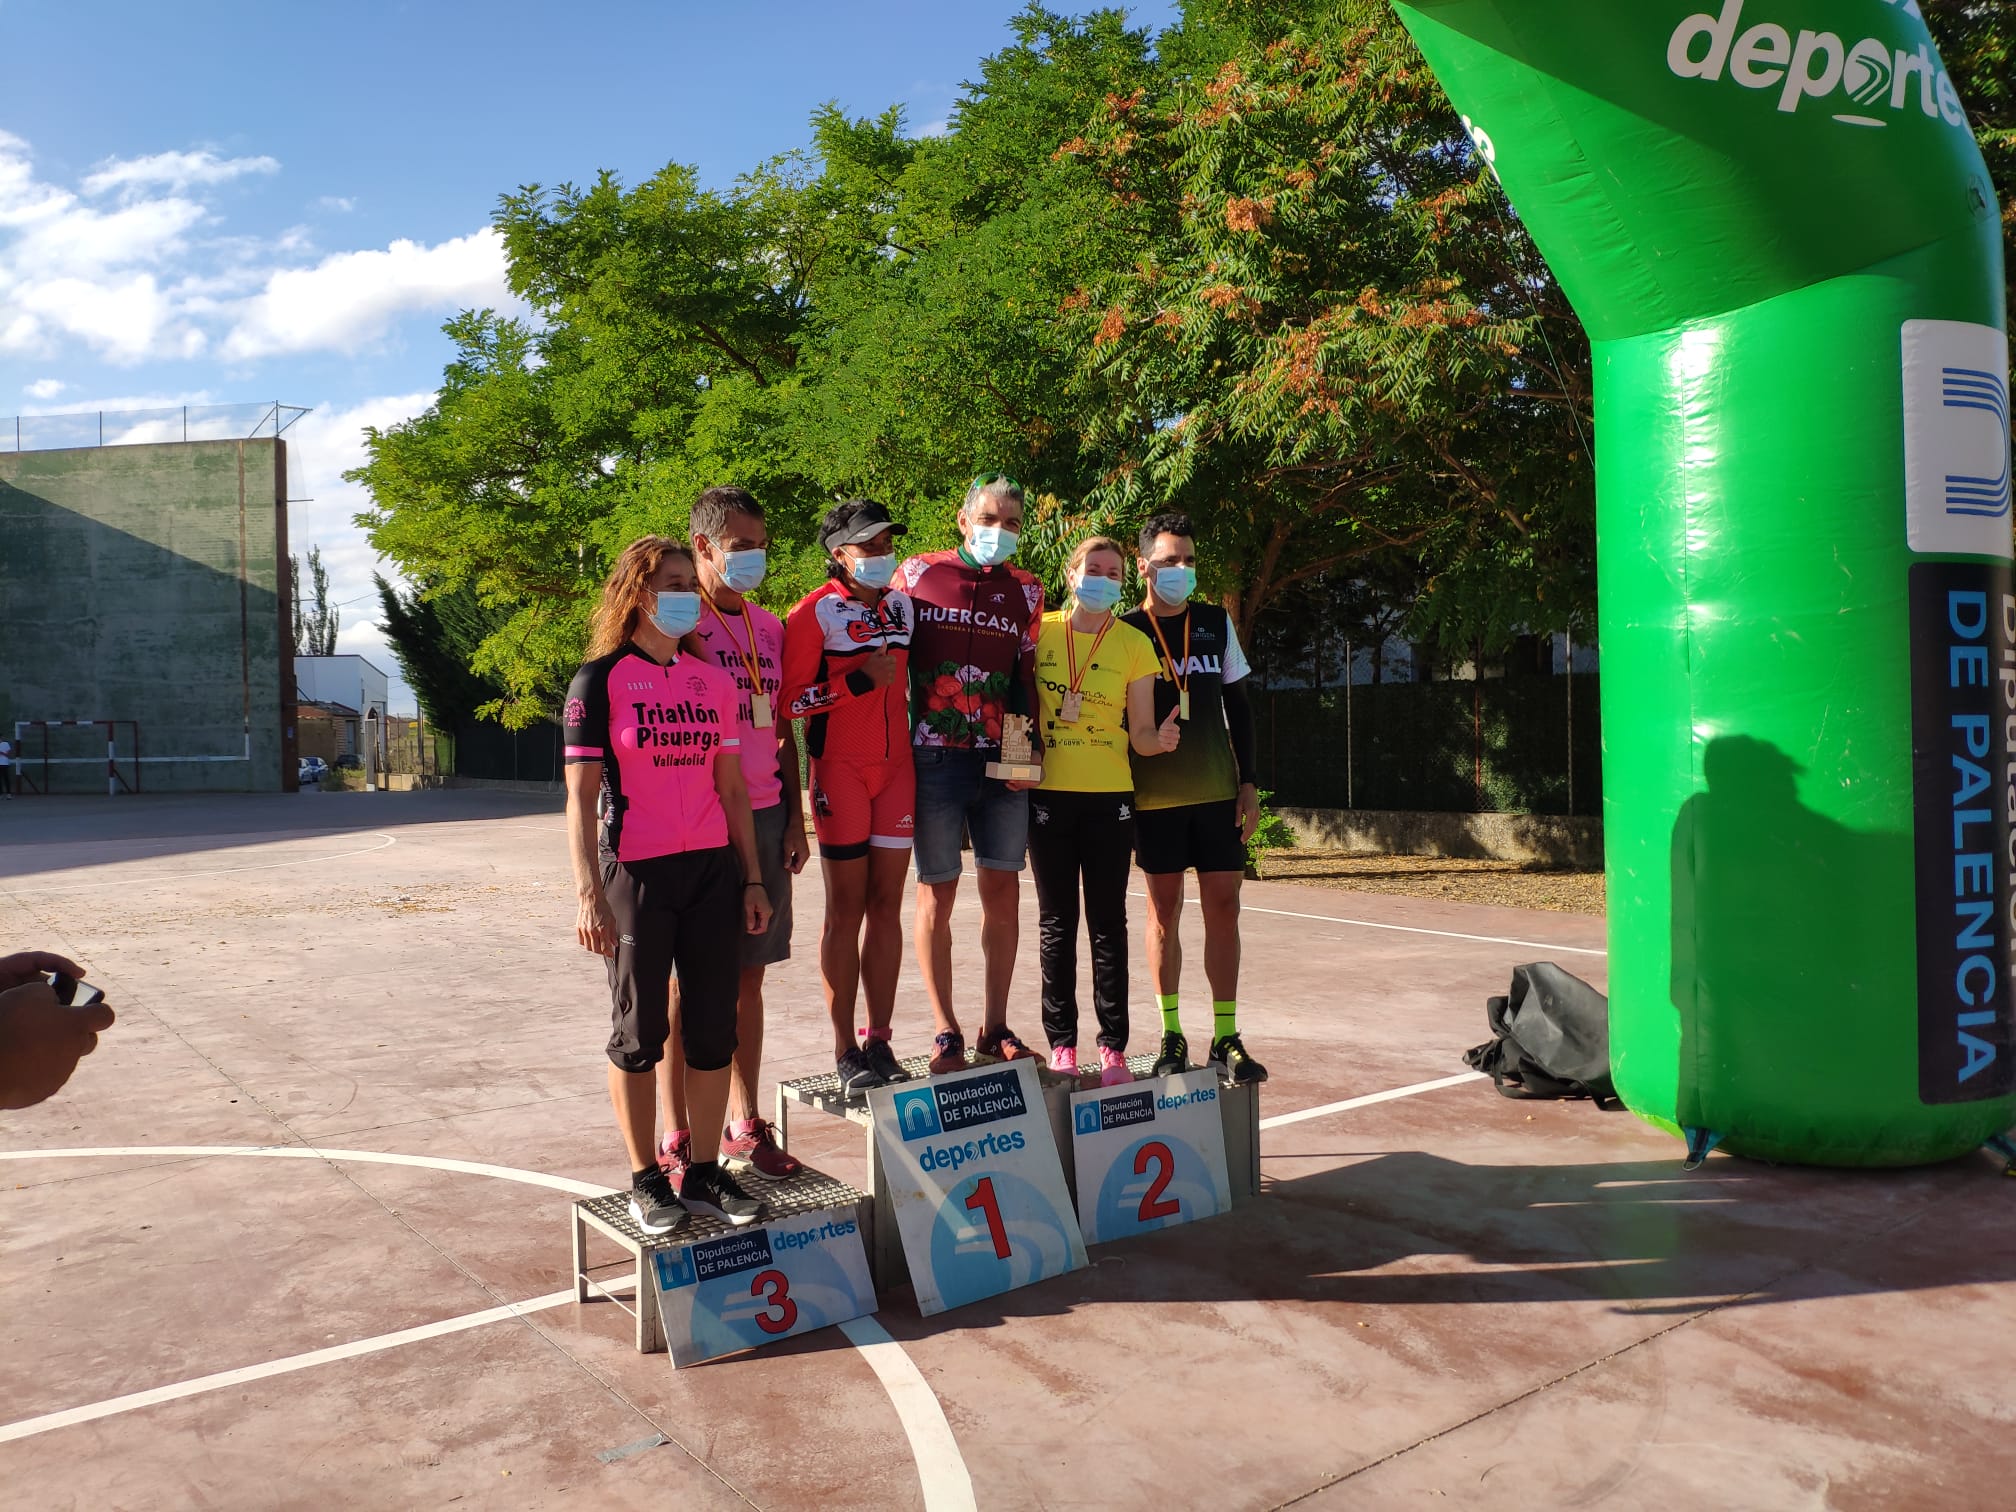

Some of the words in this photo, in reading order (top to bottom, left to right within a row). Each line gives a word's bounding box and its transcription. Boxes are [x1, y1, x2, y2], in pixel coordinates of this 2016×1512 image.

[1667, 0, 1975, 139] deporte
[919, 607, 1019, 637] HUERCASA
[977, 629, 1005, 638] COUNTRY
[1948, 591, 1989, 688] DE
[715, 650, 775, 669] Triaón
[730, 671, 780, 695] surga
[632, 700, 720, 725] Triatlón
[637, 726, 720, 751] Pisuerga
[653, 753, 706, 767] Valladolid
[1952, 714, 1997, 1084] PALENCIA
[939, 1080, 1003, 1105] Diputación
[1157, 1088, 1216, 1110] deportes
[944, 1110, 961, 1124] DE
[963, 1095, 1022, 1119] PALENCIA
[1102, 1098, 1143, 1114] Diputación
[1103, 1115, 1114, 1125] DE
[1115, 1107, 1153, 1122] PALENCIA
[919, 1130, 1026, 1172] deportes
[1133, 1141, 1180, 1222] 2
[965, 1176, 1012, 1260] 1
[773, 1219, 856, 1251] deportes
[696, 1238, 754, 1262] Diputación
[699, 1263, 716, 1275] DE
[717, 1249, 770, 1270] PALENCIA
[750, 1269, 798, 1334] 3
